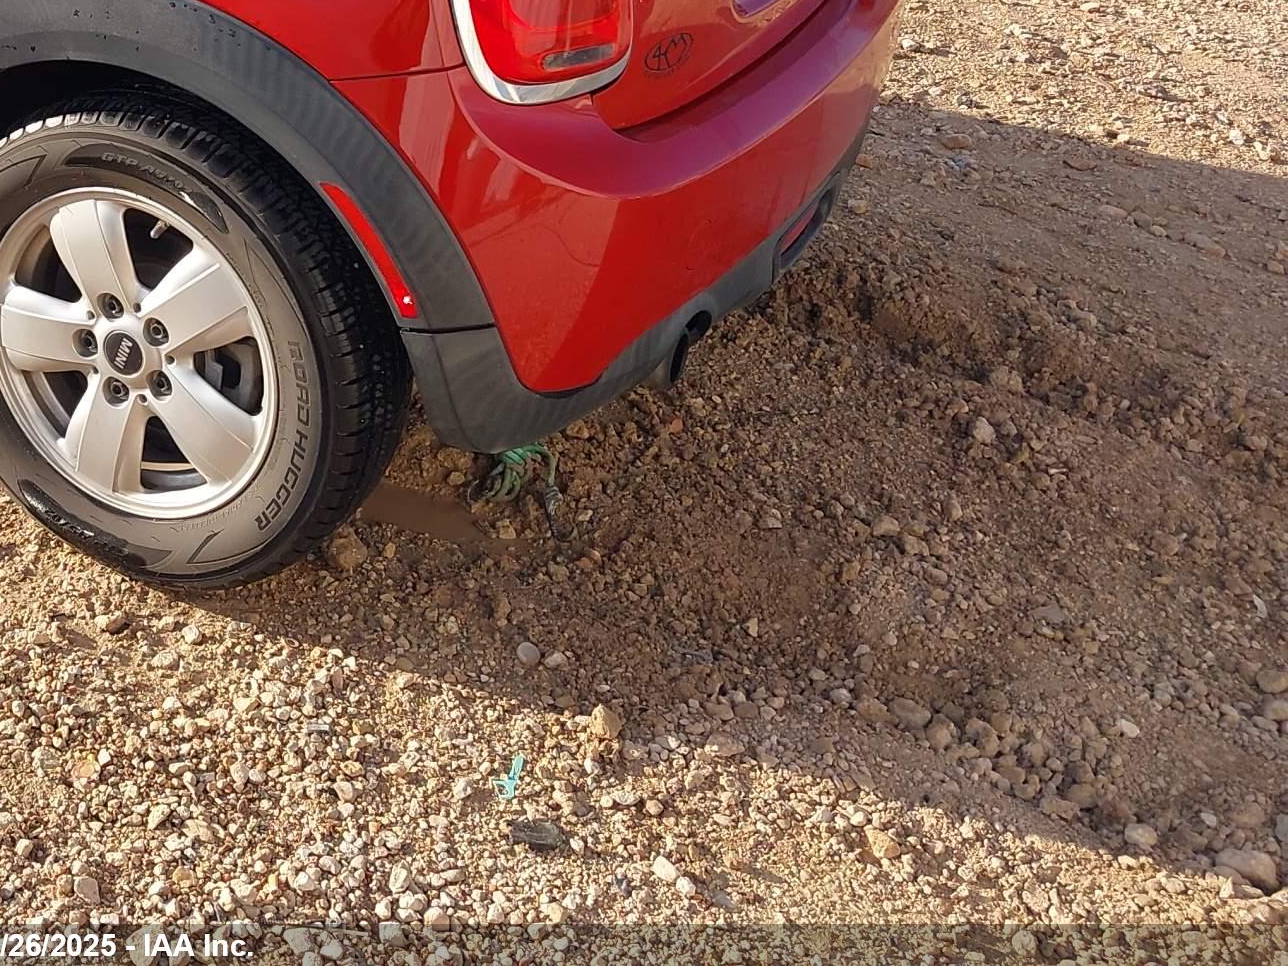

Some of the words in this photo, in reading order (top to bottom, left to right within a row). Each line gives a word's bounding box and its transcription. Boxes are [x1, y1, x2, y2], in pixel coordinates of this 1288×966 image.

[113, 337, 133, 370] MINI
[287, 340, 310, 427] ROAD
[253, 429, 309, 531] HUGGER
